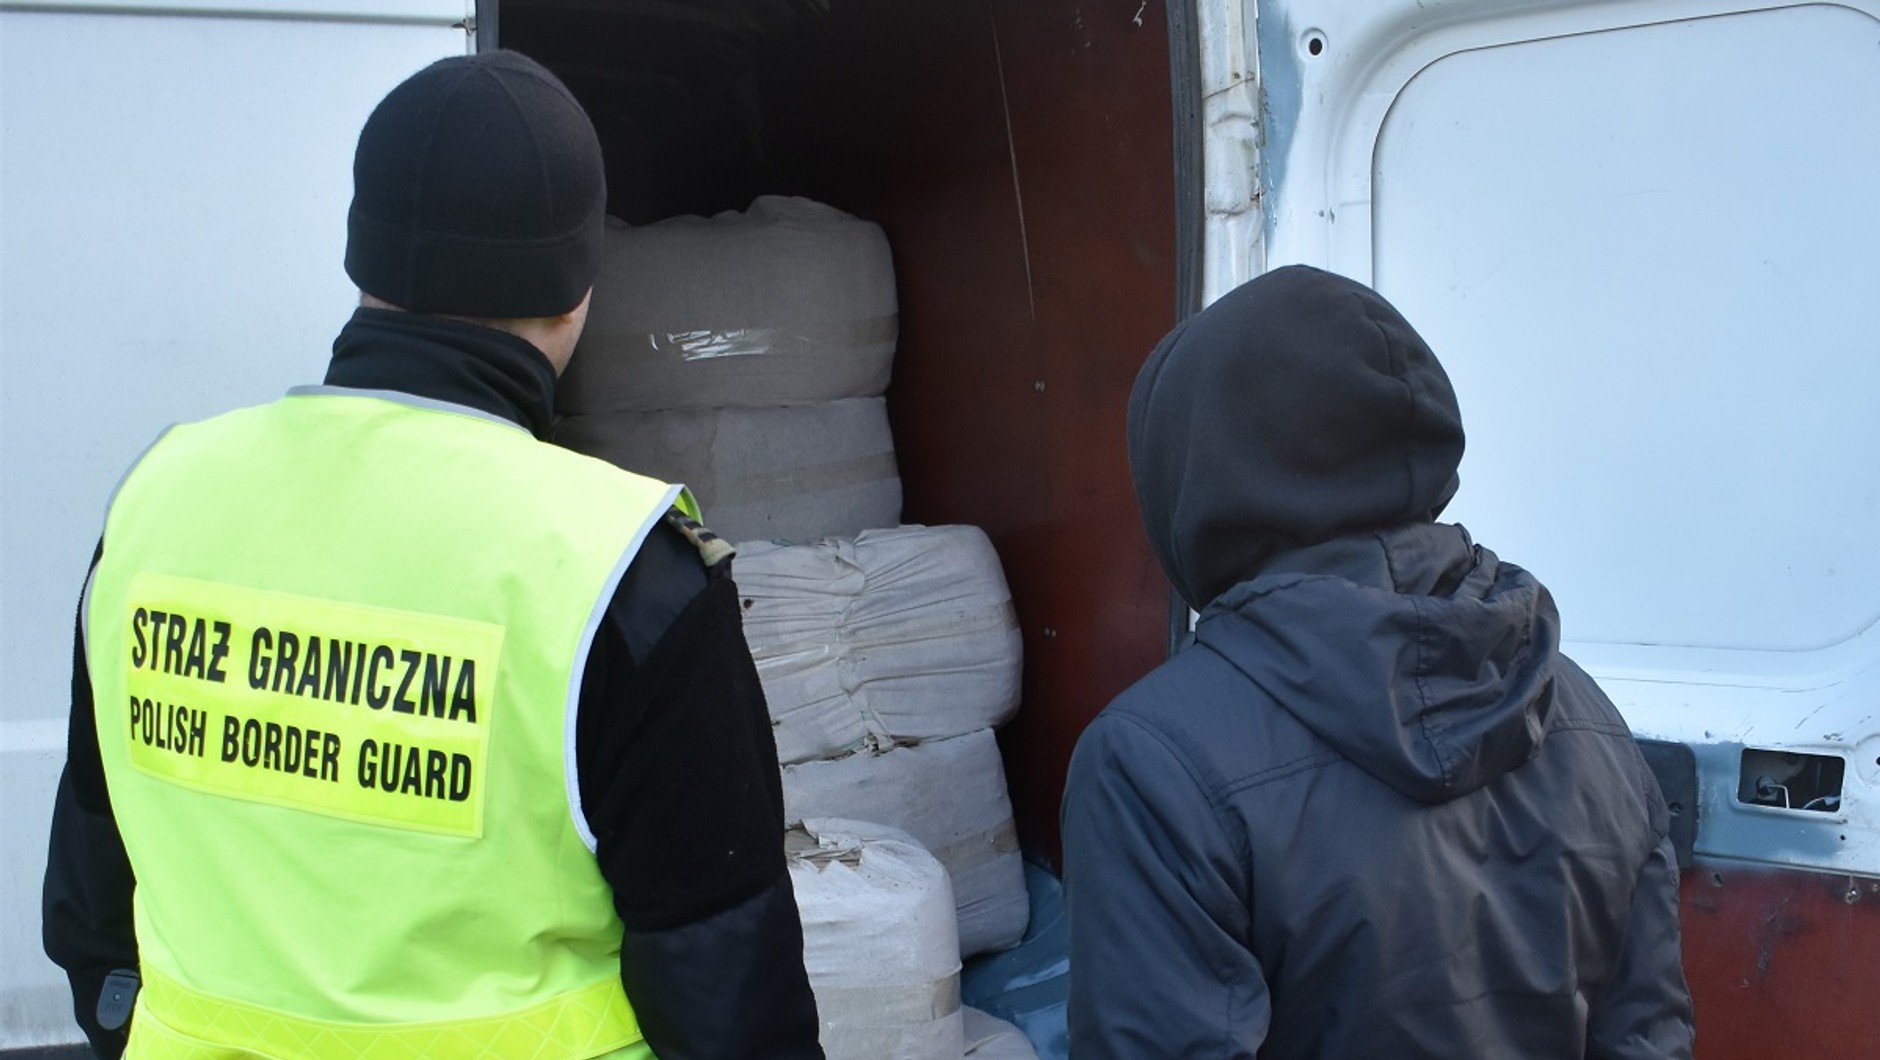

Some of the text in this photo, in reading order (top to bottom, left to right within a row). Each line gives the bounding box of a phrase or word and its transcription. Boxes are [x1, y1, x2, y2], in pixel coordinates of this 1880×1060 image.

[247, 626, 477, 724] GRANICZNA
[129, 695, 472, 803] POLISH BORDER GUARD
